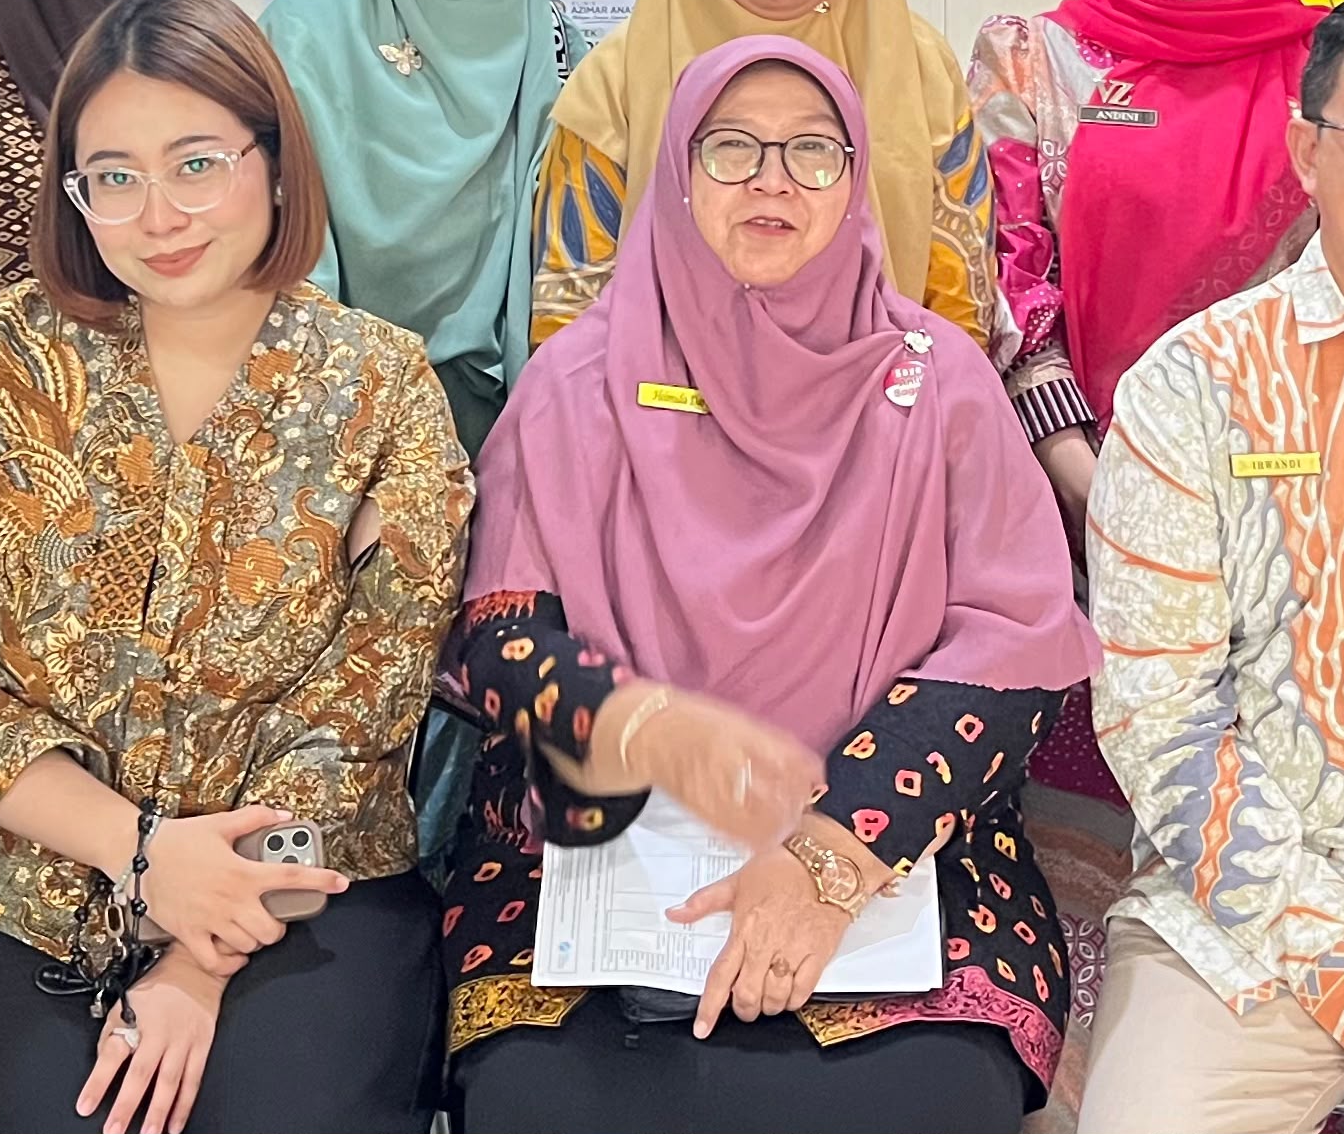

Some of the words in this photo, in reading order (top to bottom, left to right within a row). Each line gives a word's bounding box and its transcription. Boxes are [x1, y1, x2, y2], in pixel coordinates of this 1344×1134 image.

[571, 6, 608, 14] AZIMAR
[610, 6, 631, 14] ANA
[1096, 110, 1139, 122] ANDINI
[1252, 458, 1301, 470] IRWANDI
